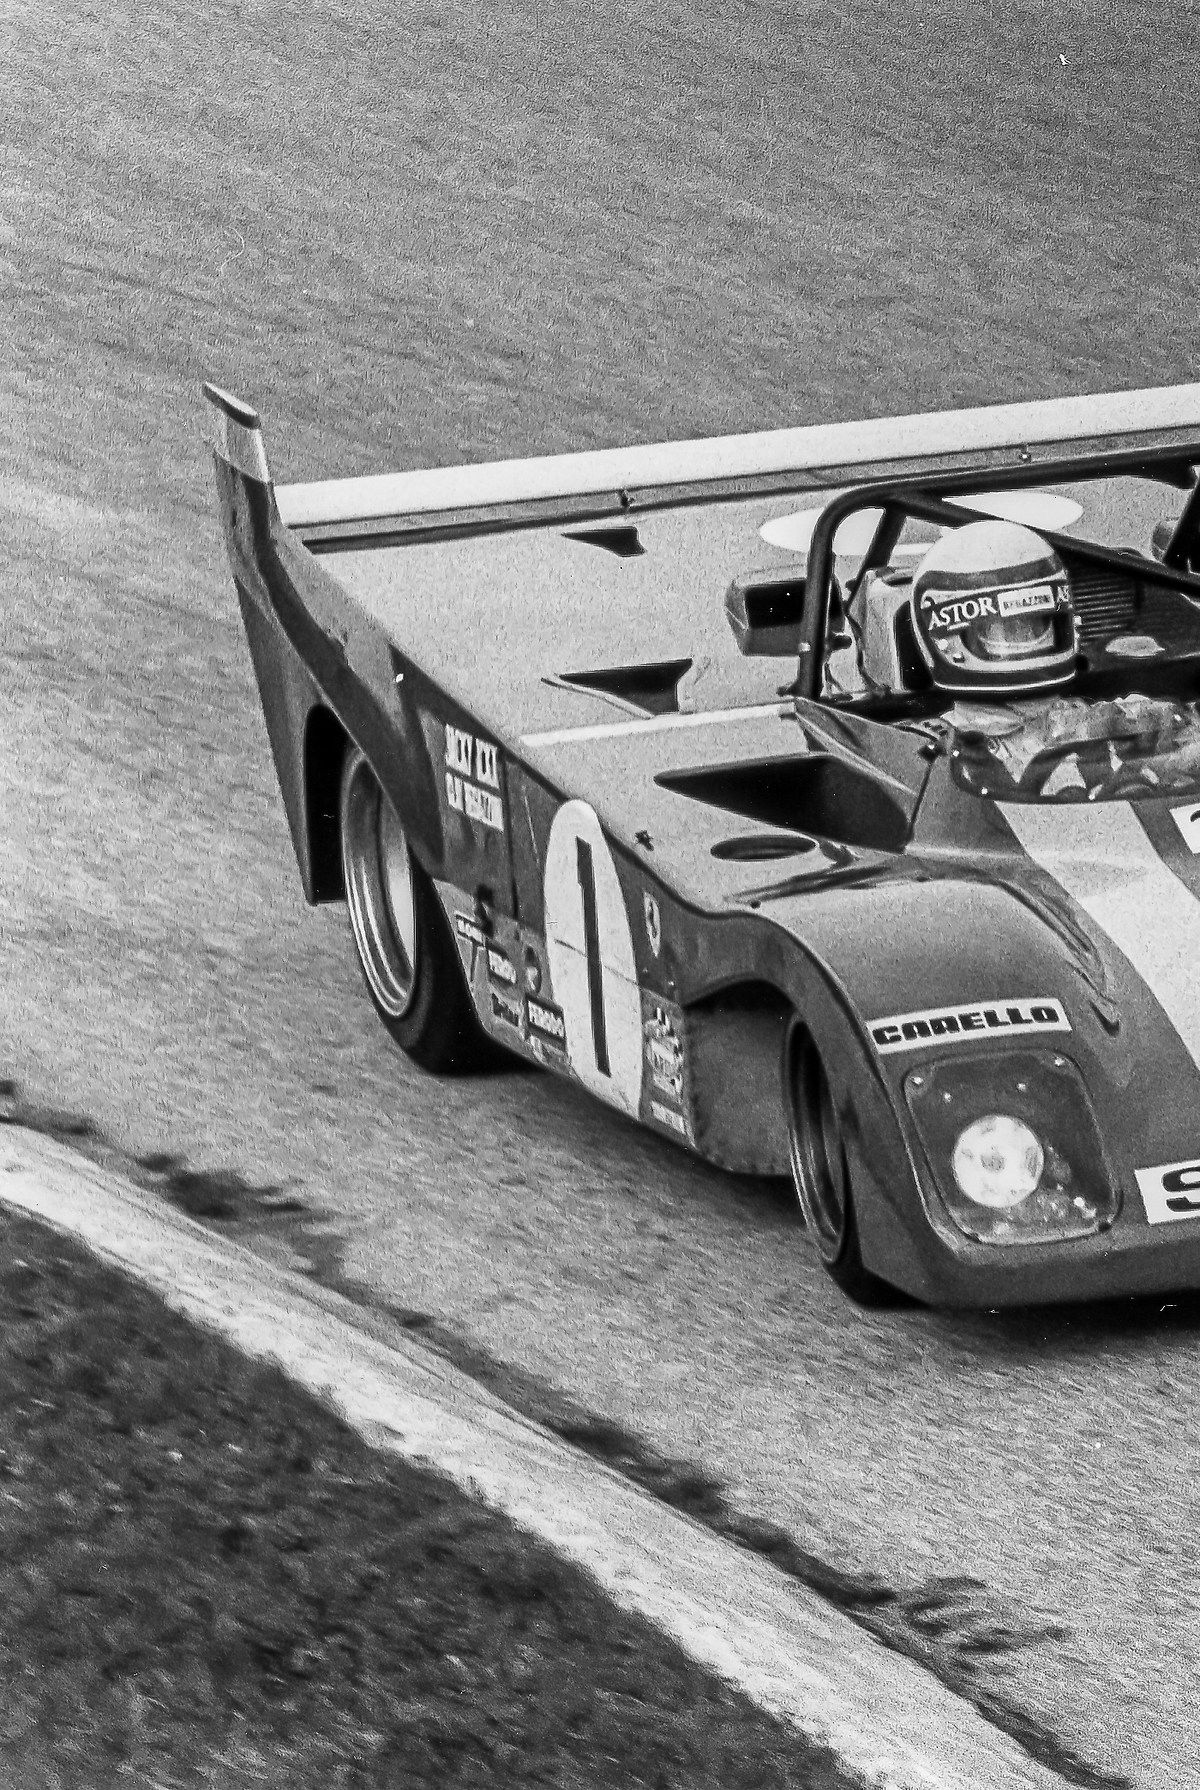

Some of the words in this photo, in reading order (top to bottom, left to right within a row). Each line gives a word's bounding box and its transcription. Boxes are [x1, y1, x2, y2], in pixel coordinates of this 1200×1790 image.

[928, 596, 998, 630] ASTOR
[575, 835, 612, 1078] 1
[872, 1006, 1060, 1046] CARELLO
